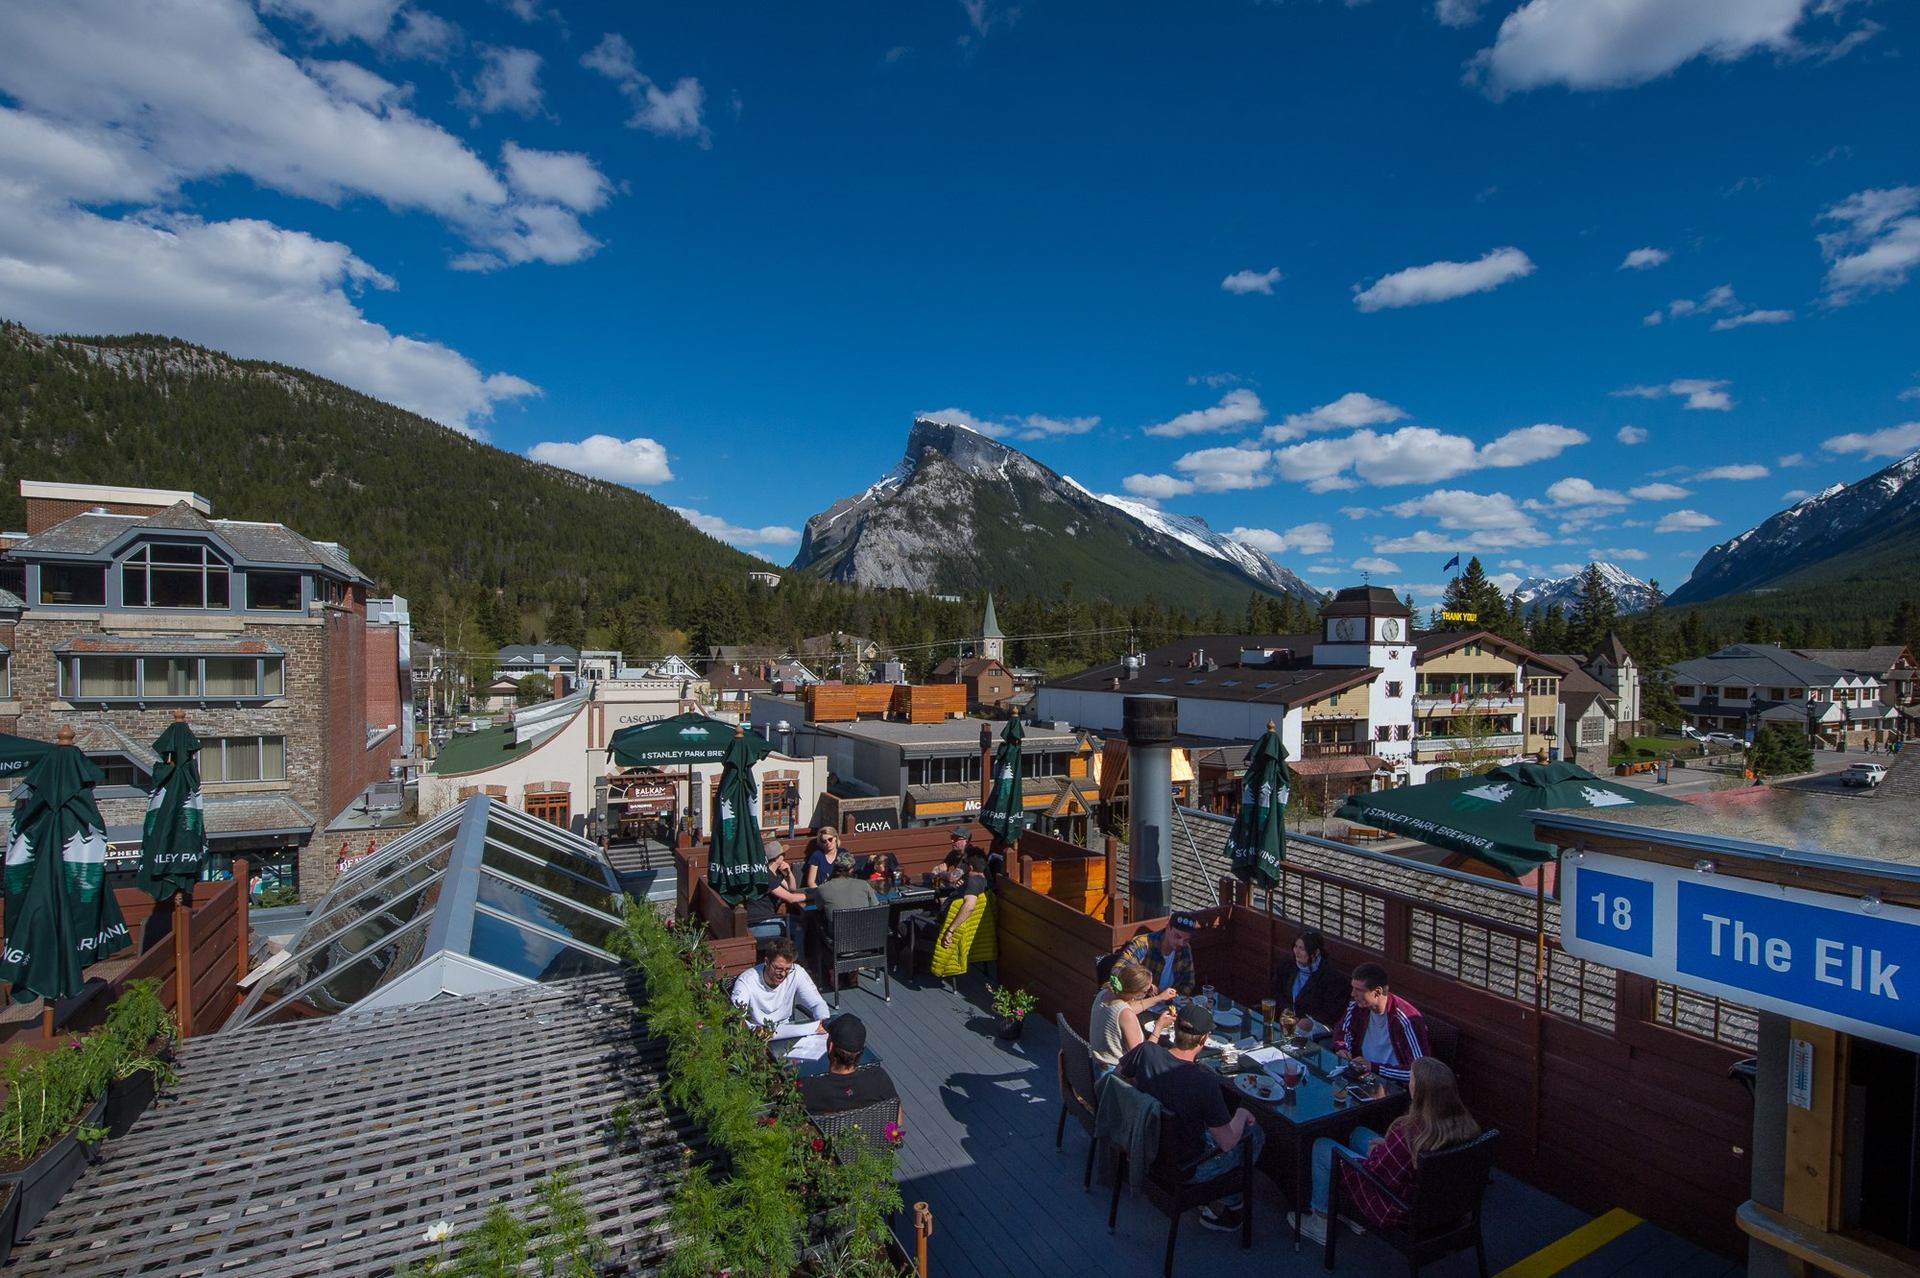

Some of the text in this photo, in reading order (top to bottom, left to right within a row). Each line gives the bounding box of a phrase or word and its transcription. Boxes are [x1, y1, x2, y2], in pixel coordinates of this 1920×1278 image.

[1441, 611, 1463, 621] THANK
[647, 751, 682, 760] STANLEY
[684, 750, 706, 758] PARK
[635, 786, 666, 796] BALKAN
[855, 821, 891, 833] CHAYA
[1368, 807, 1488, 847] STANLEY PARK BREWING
[1591, 892, 1632, 931] 18
[1702, 913, 1900, 1001] The Elk
